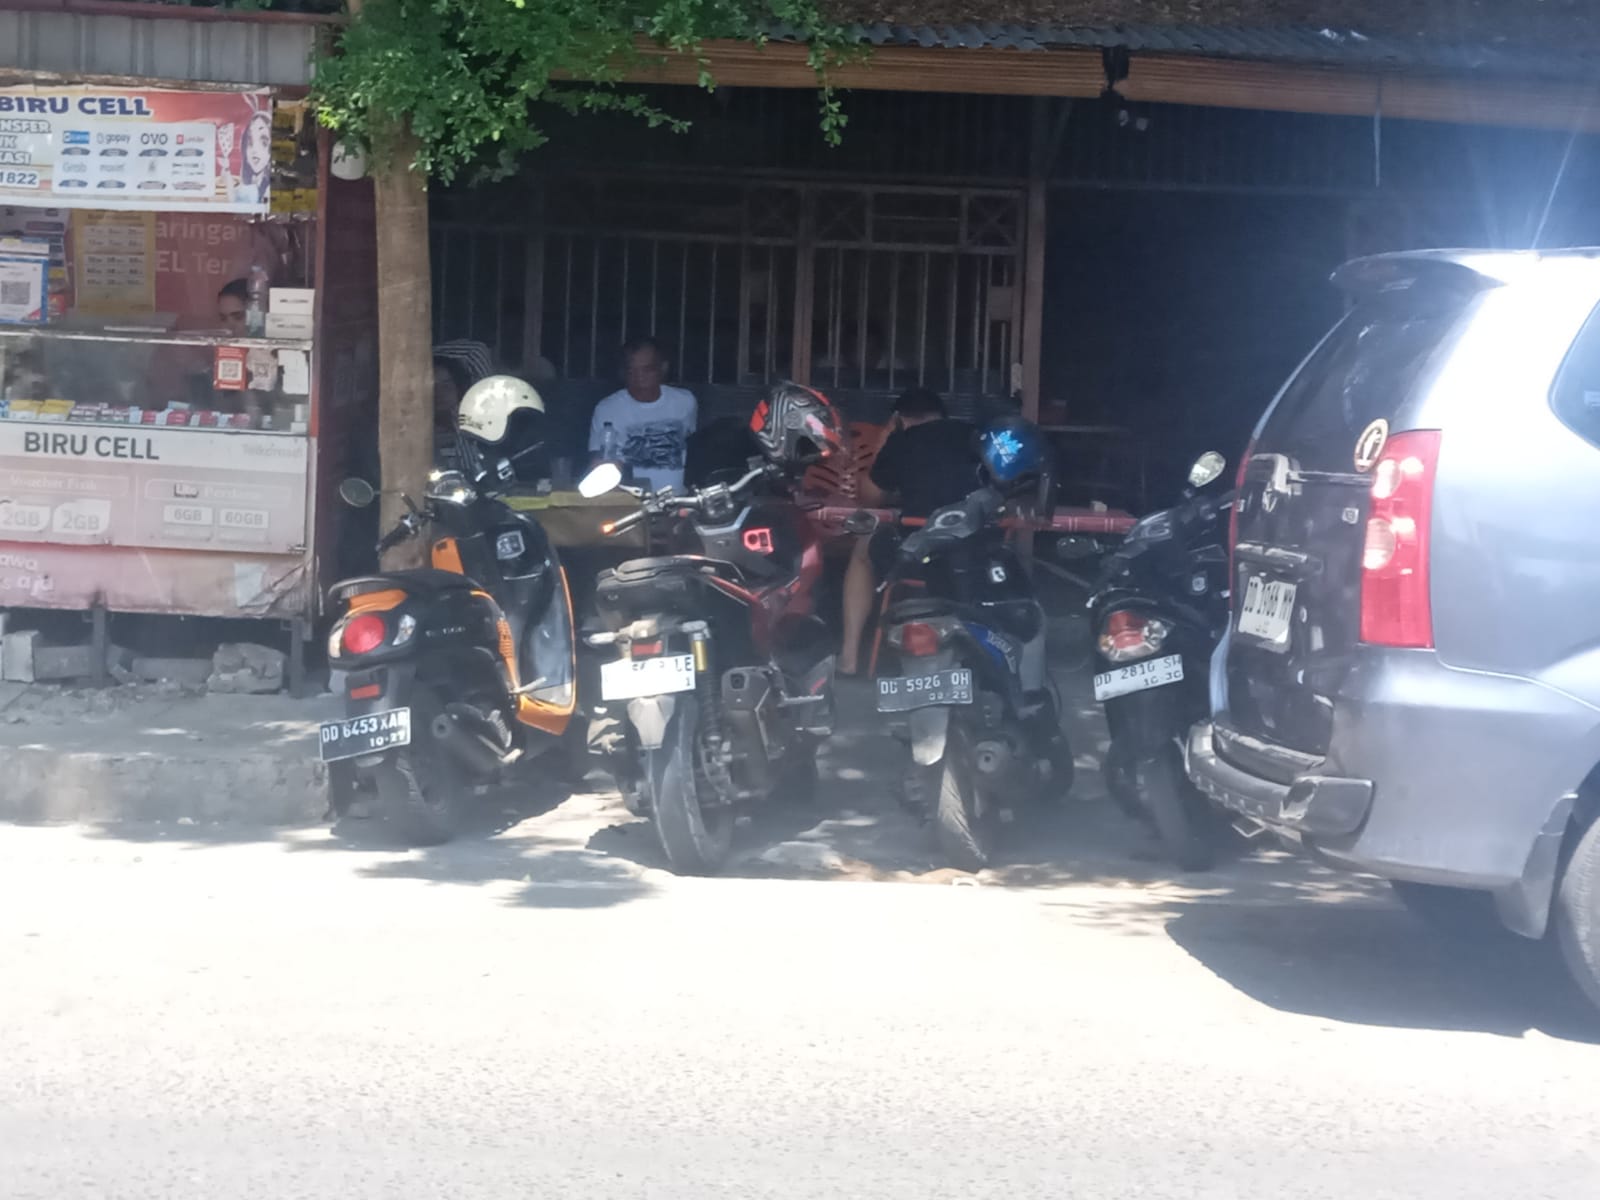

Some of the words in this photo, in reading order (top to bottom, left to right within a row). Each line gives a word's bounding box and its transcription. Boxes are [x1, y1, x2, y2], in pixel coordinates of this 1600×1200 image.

[0, 97, 69, 114] BIRU
[78, 97, 151, 116] CELL
[140, 132, 169, 145] OVO
[24, 431, 88, 456] BIRU
[94, 436, 160, 460] CELL
[61, 509, 100, 530] 2GB
[906, 674, 941, 692] 5926
[322, 724, 339, 743] DD
